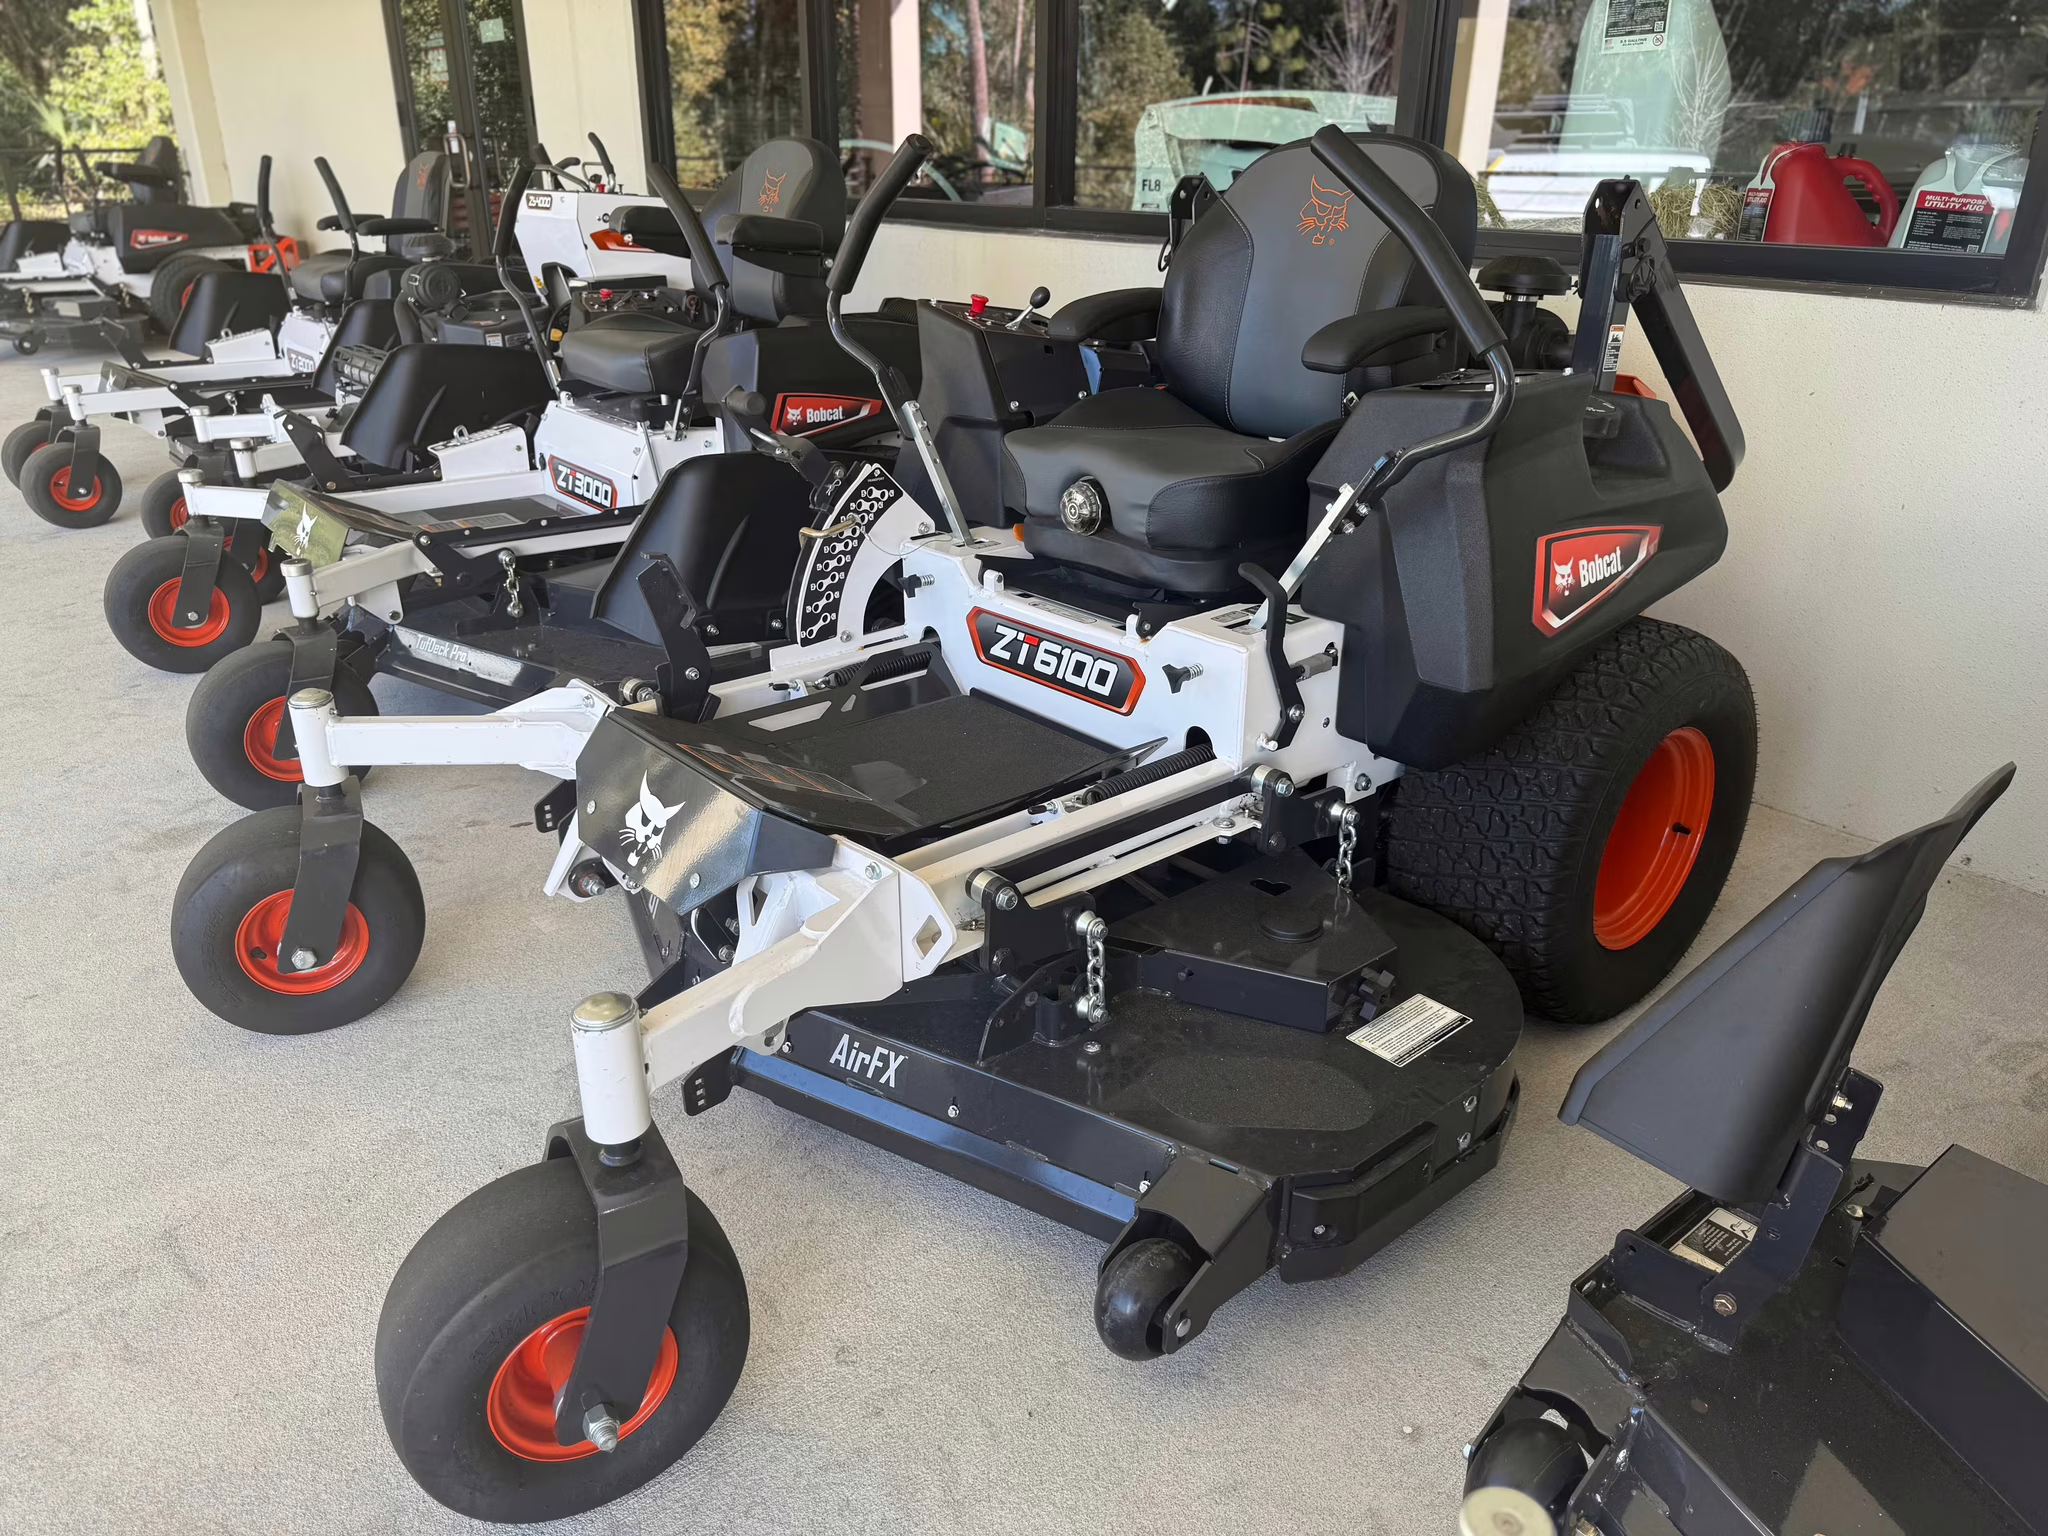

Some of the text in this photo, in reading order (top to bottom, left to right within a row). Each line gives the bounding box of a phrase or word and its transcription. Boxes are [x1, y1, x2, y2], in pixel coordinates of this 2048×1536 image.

[1142, 179, 1161, 192] FL8
[1925, 194, 1988, 206] MULTI-PURPOSE
[1924, 200, 1985, 212] UTILITY JUG
[806, 405, 843, 424] Bobcat
[557, 464, 612, 508] ZT3000
[1578, 546, 1622, 588] Bobcat
[415, 634, 468, 663] TufDeck Pro
[989, 624, 1119, 697] ZT6100
[829, 1033, 905, 1088] AirFX
